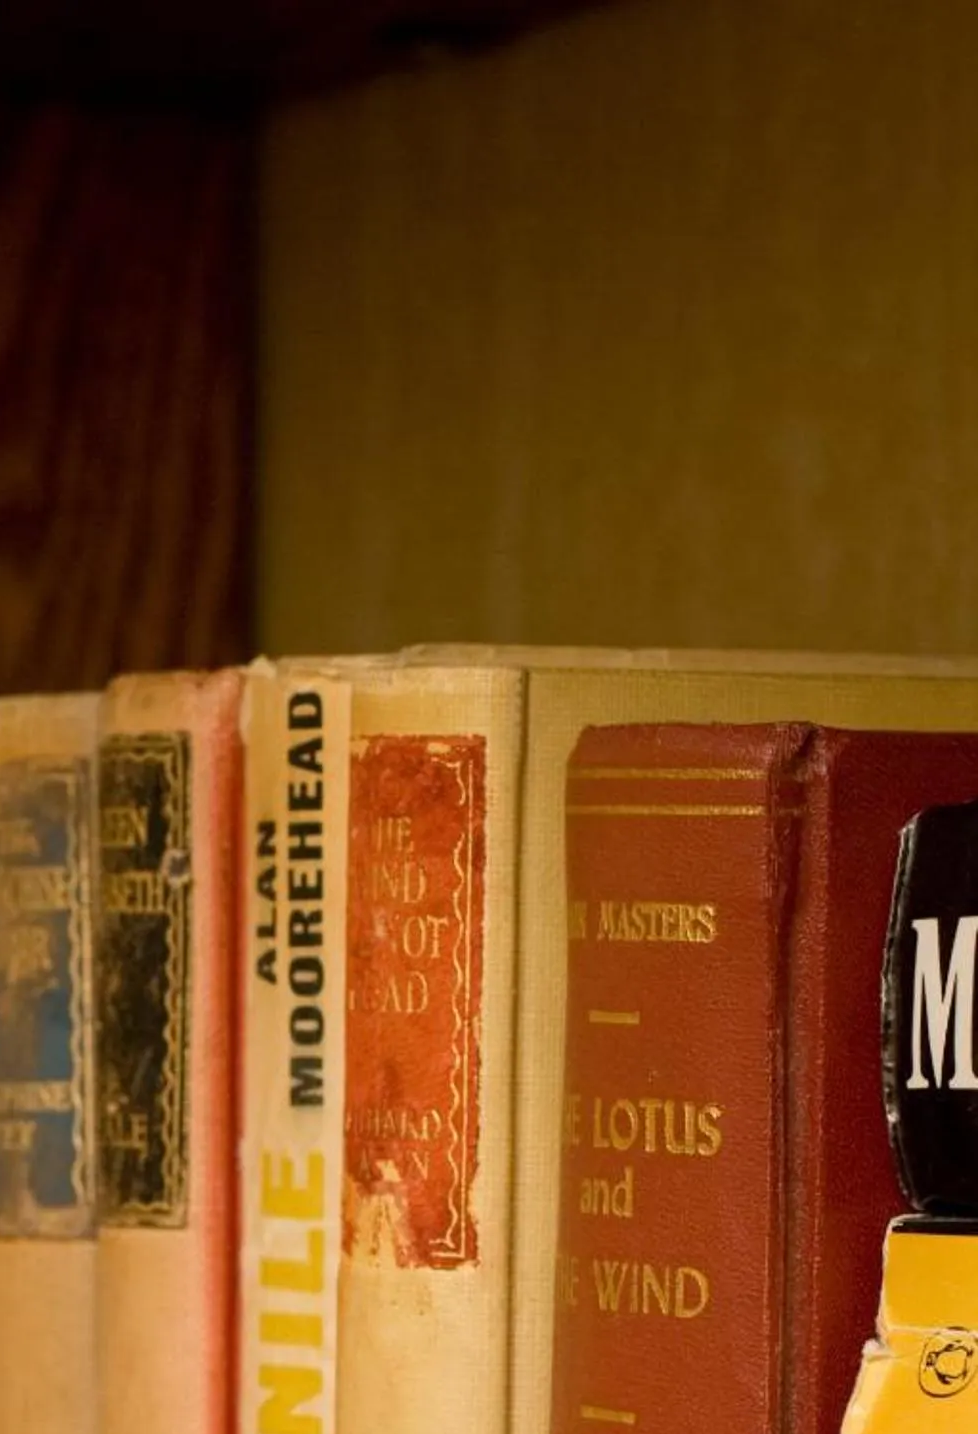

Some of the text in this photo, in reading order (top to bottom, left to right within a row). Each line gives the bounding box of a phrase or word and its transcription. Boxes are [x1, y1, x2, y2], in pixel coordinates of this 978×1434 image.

[257, 819, 278, 987] ALAN
[287, 690, 326, 1109] MOOREHEAD
[596, 899, 718, 943] MASTERS
[592, 1095, 726, 1157] LOTUS
[578, 1165, 634, 1219] and
[591, 1257, 711, 1320] WIND
